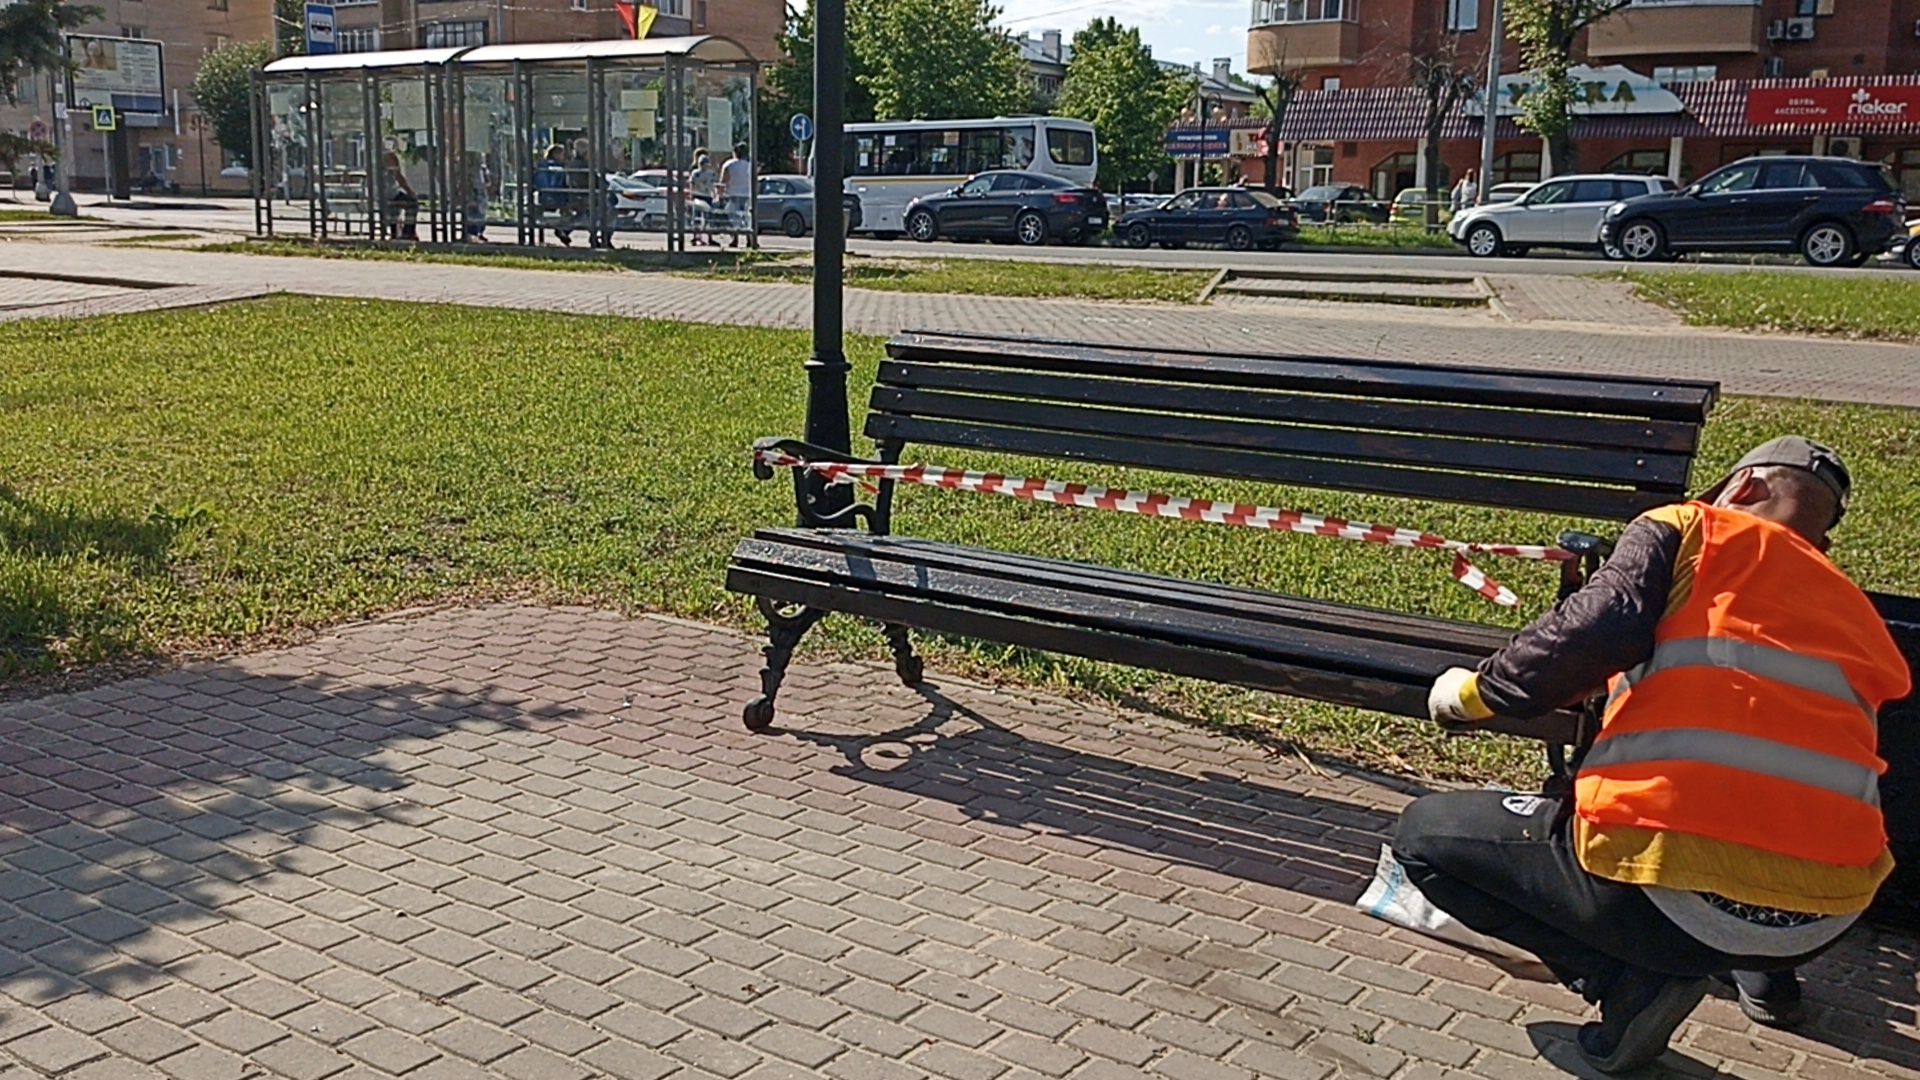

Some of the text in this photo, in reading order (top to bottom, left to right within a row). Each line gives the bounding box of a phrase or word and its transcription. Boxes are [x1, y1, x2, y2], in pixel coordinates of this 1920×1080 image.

[1507, 80, 1636, 104] УКА
[1774, 107, 1828, 115] АКСЕССУАРЫ
[1847, 94, 1907, 115] rieker
